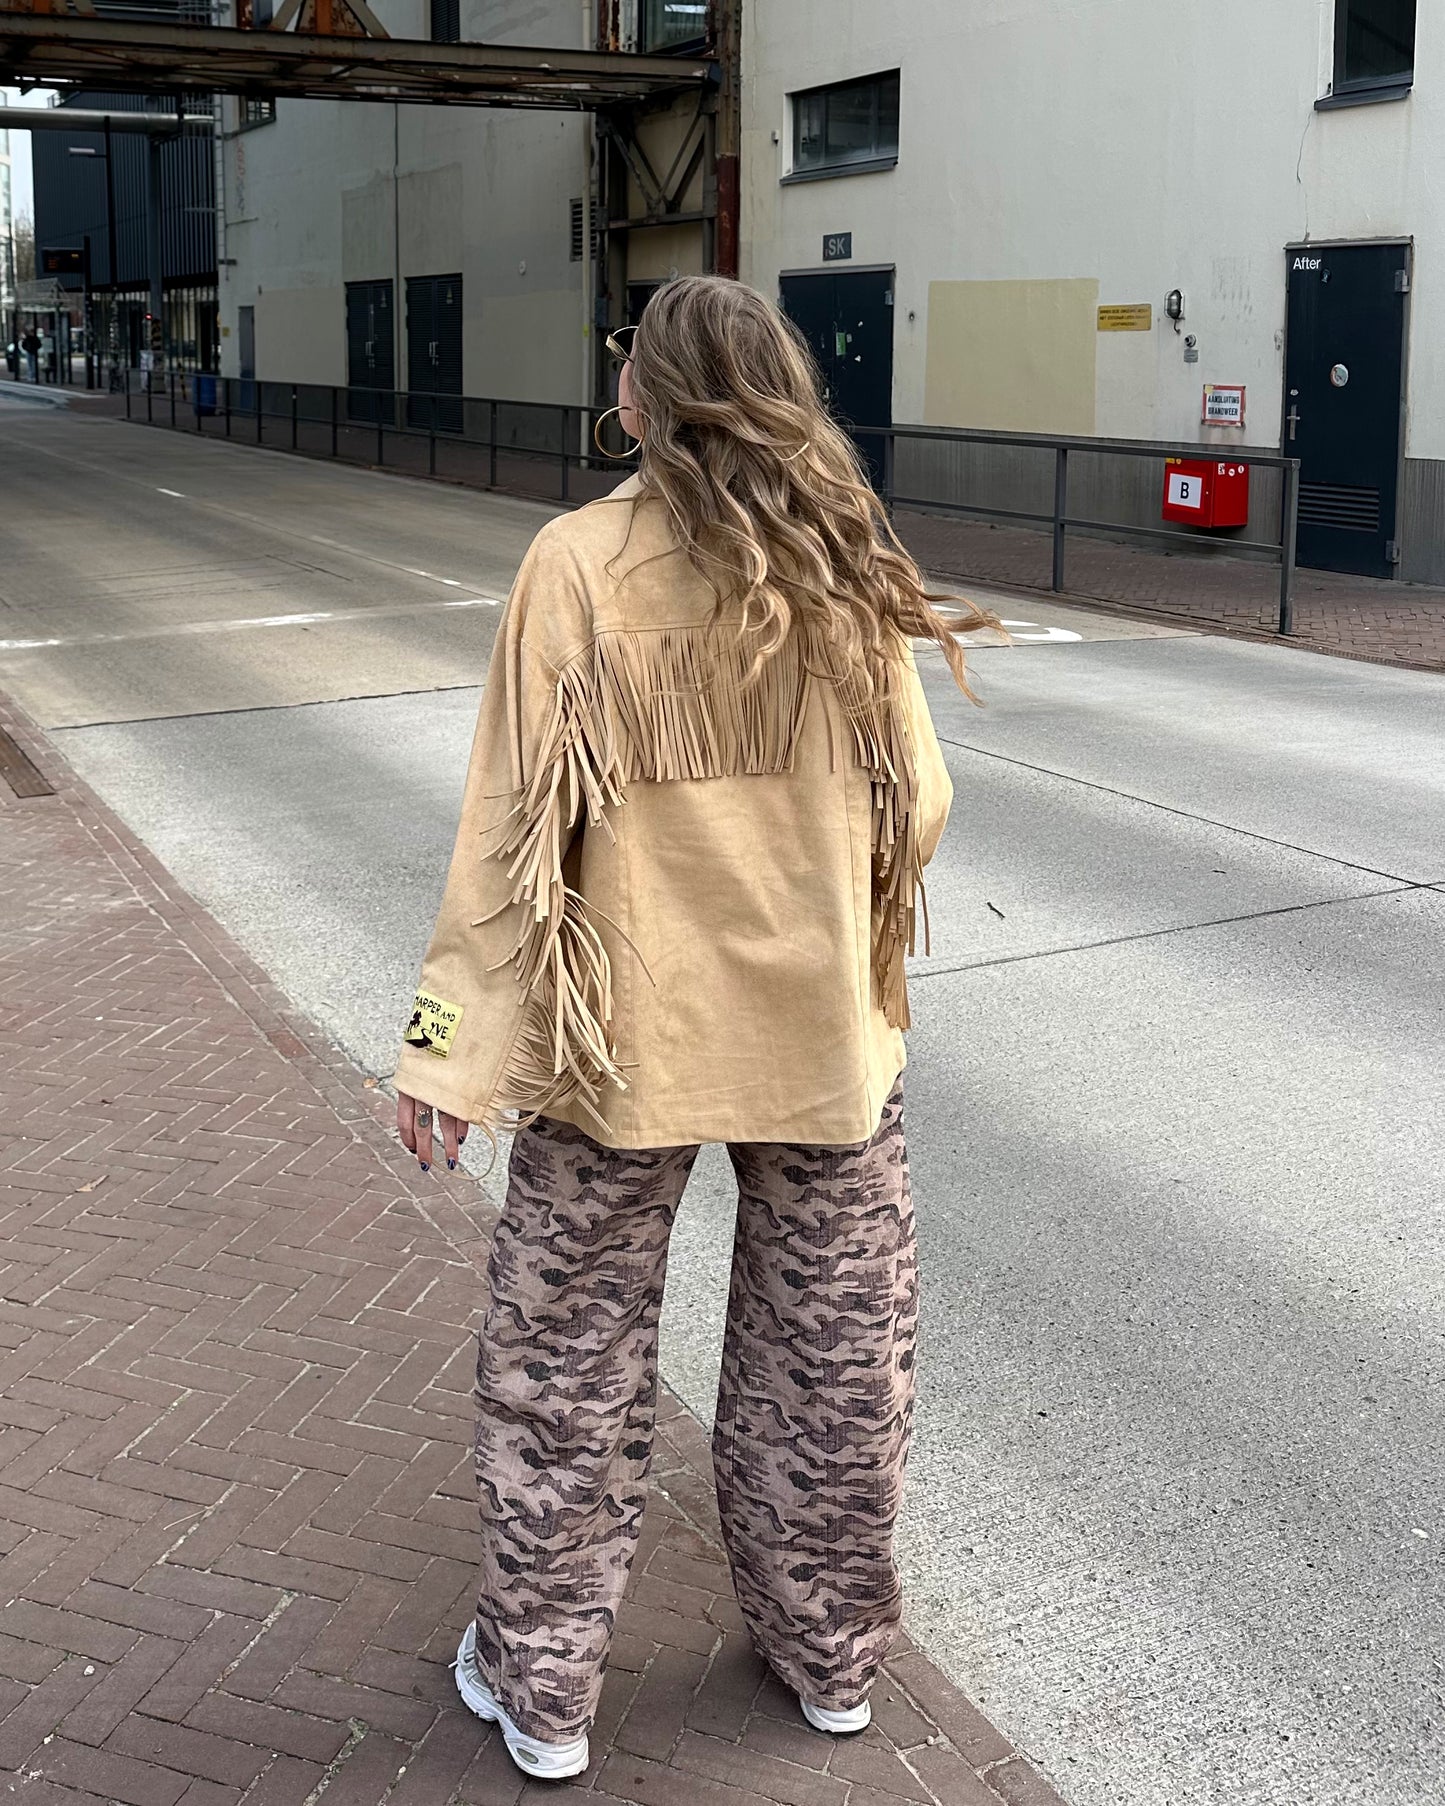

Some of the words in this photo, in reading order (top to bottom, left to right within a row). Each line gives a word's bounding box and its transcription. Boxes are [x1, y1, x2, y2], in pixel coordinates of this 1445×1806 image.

[1293, 257, 1321, 270] After
[1180, 482, 1189, 499] B
[440, 1011, 456, 1023] AND
[429, 1022, 448, 1039] YVE
